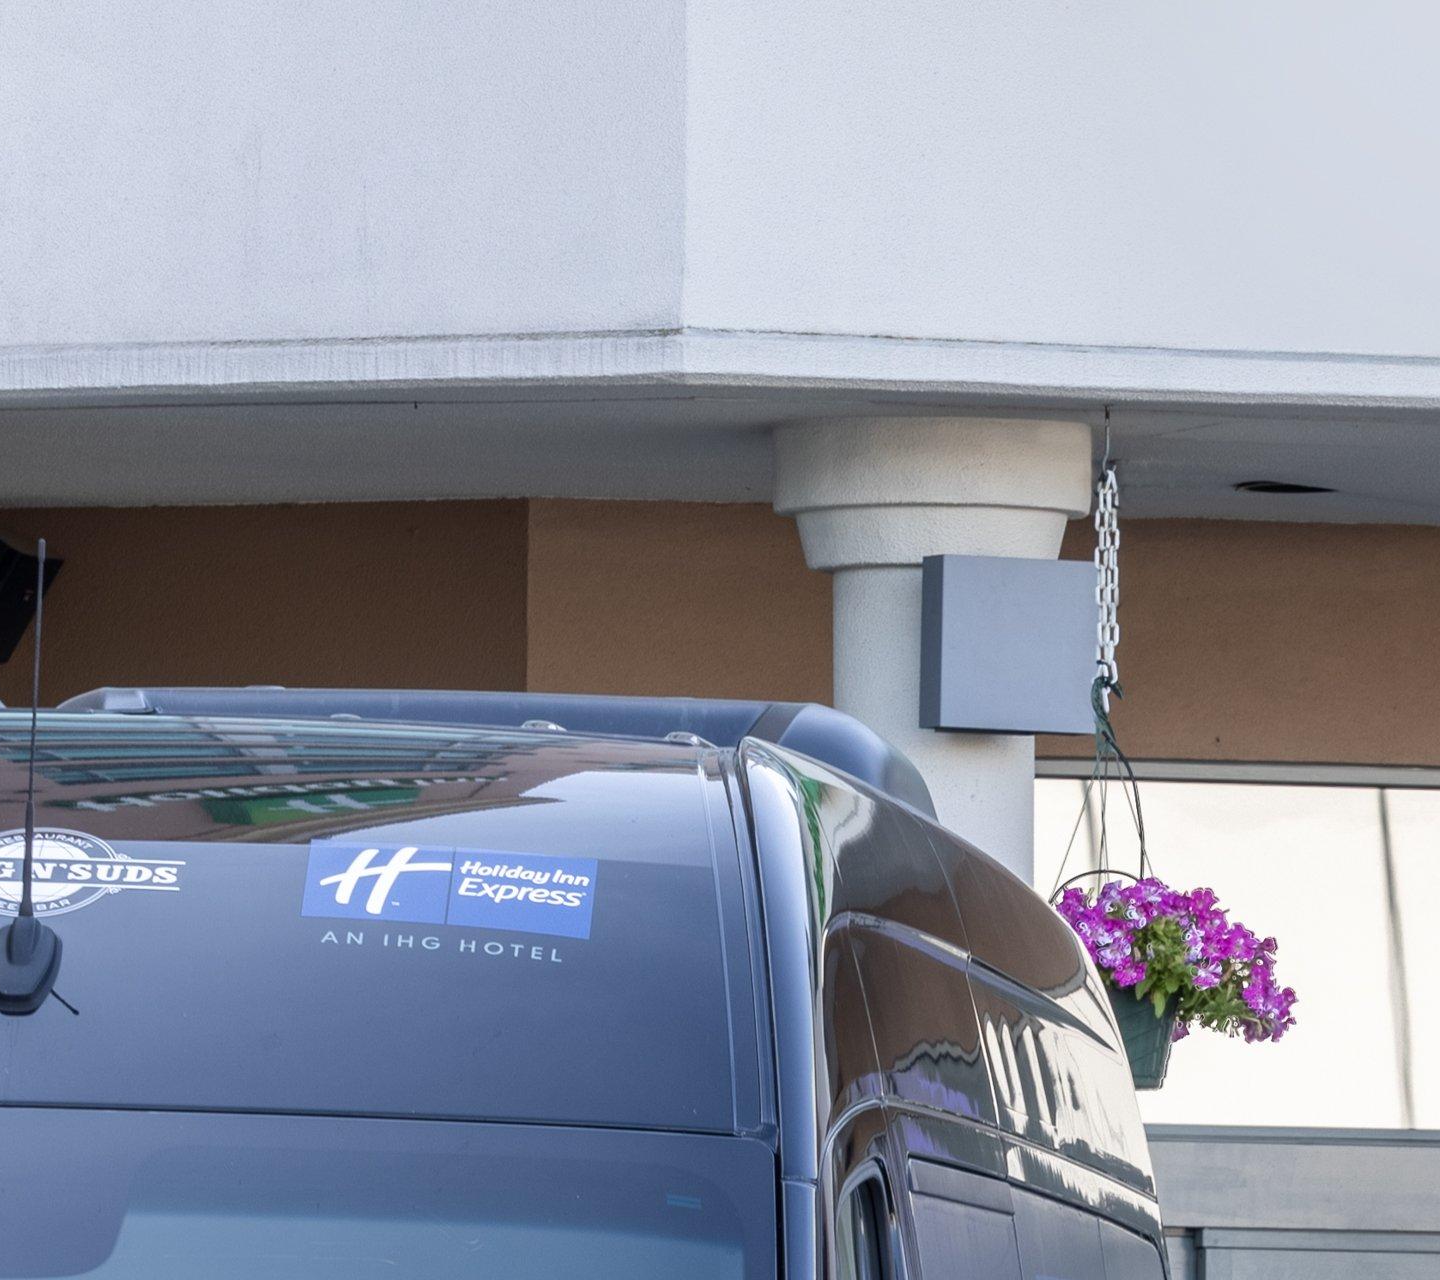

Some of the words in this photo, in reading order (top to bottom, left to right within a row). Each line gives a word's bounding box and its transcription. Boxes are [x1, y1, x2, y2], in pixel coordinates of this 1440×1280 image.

[460, 860, 551, 885] Holiday
[552, 869, 590, 887] Inn
[36, 898, 72, 911] BAR
[458, 877, 583, 907] Express
[321, 930, 364, 945] AN
[383, 933, 441, 949] IHG
[459, 940, 563, 962] HOTEL
